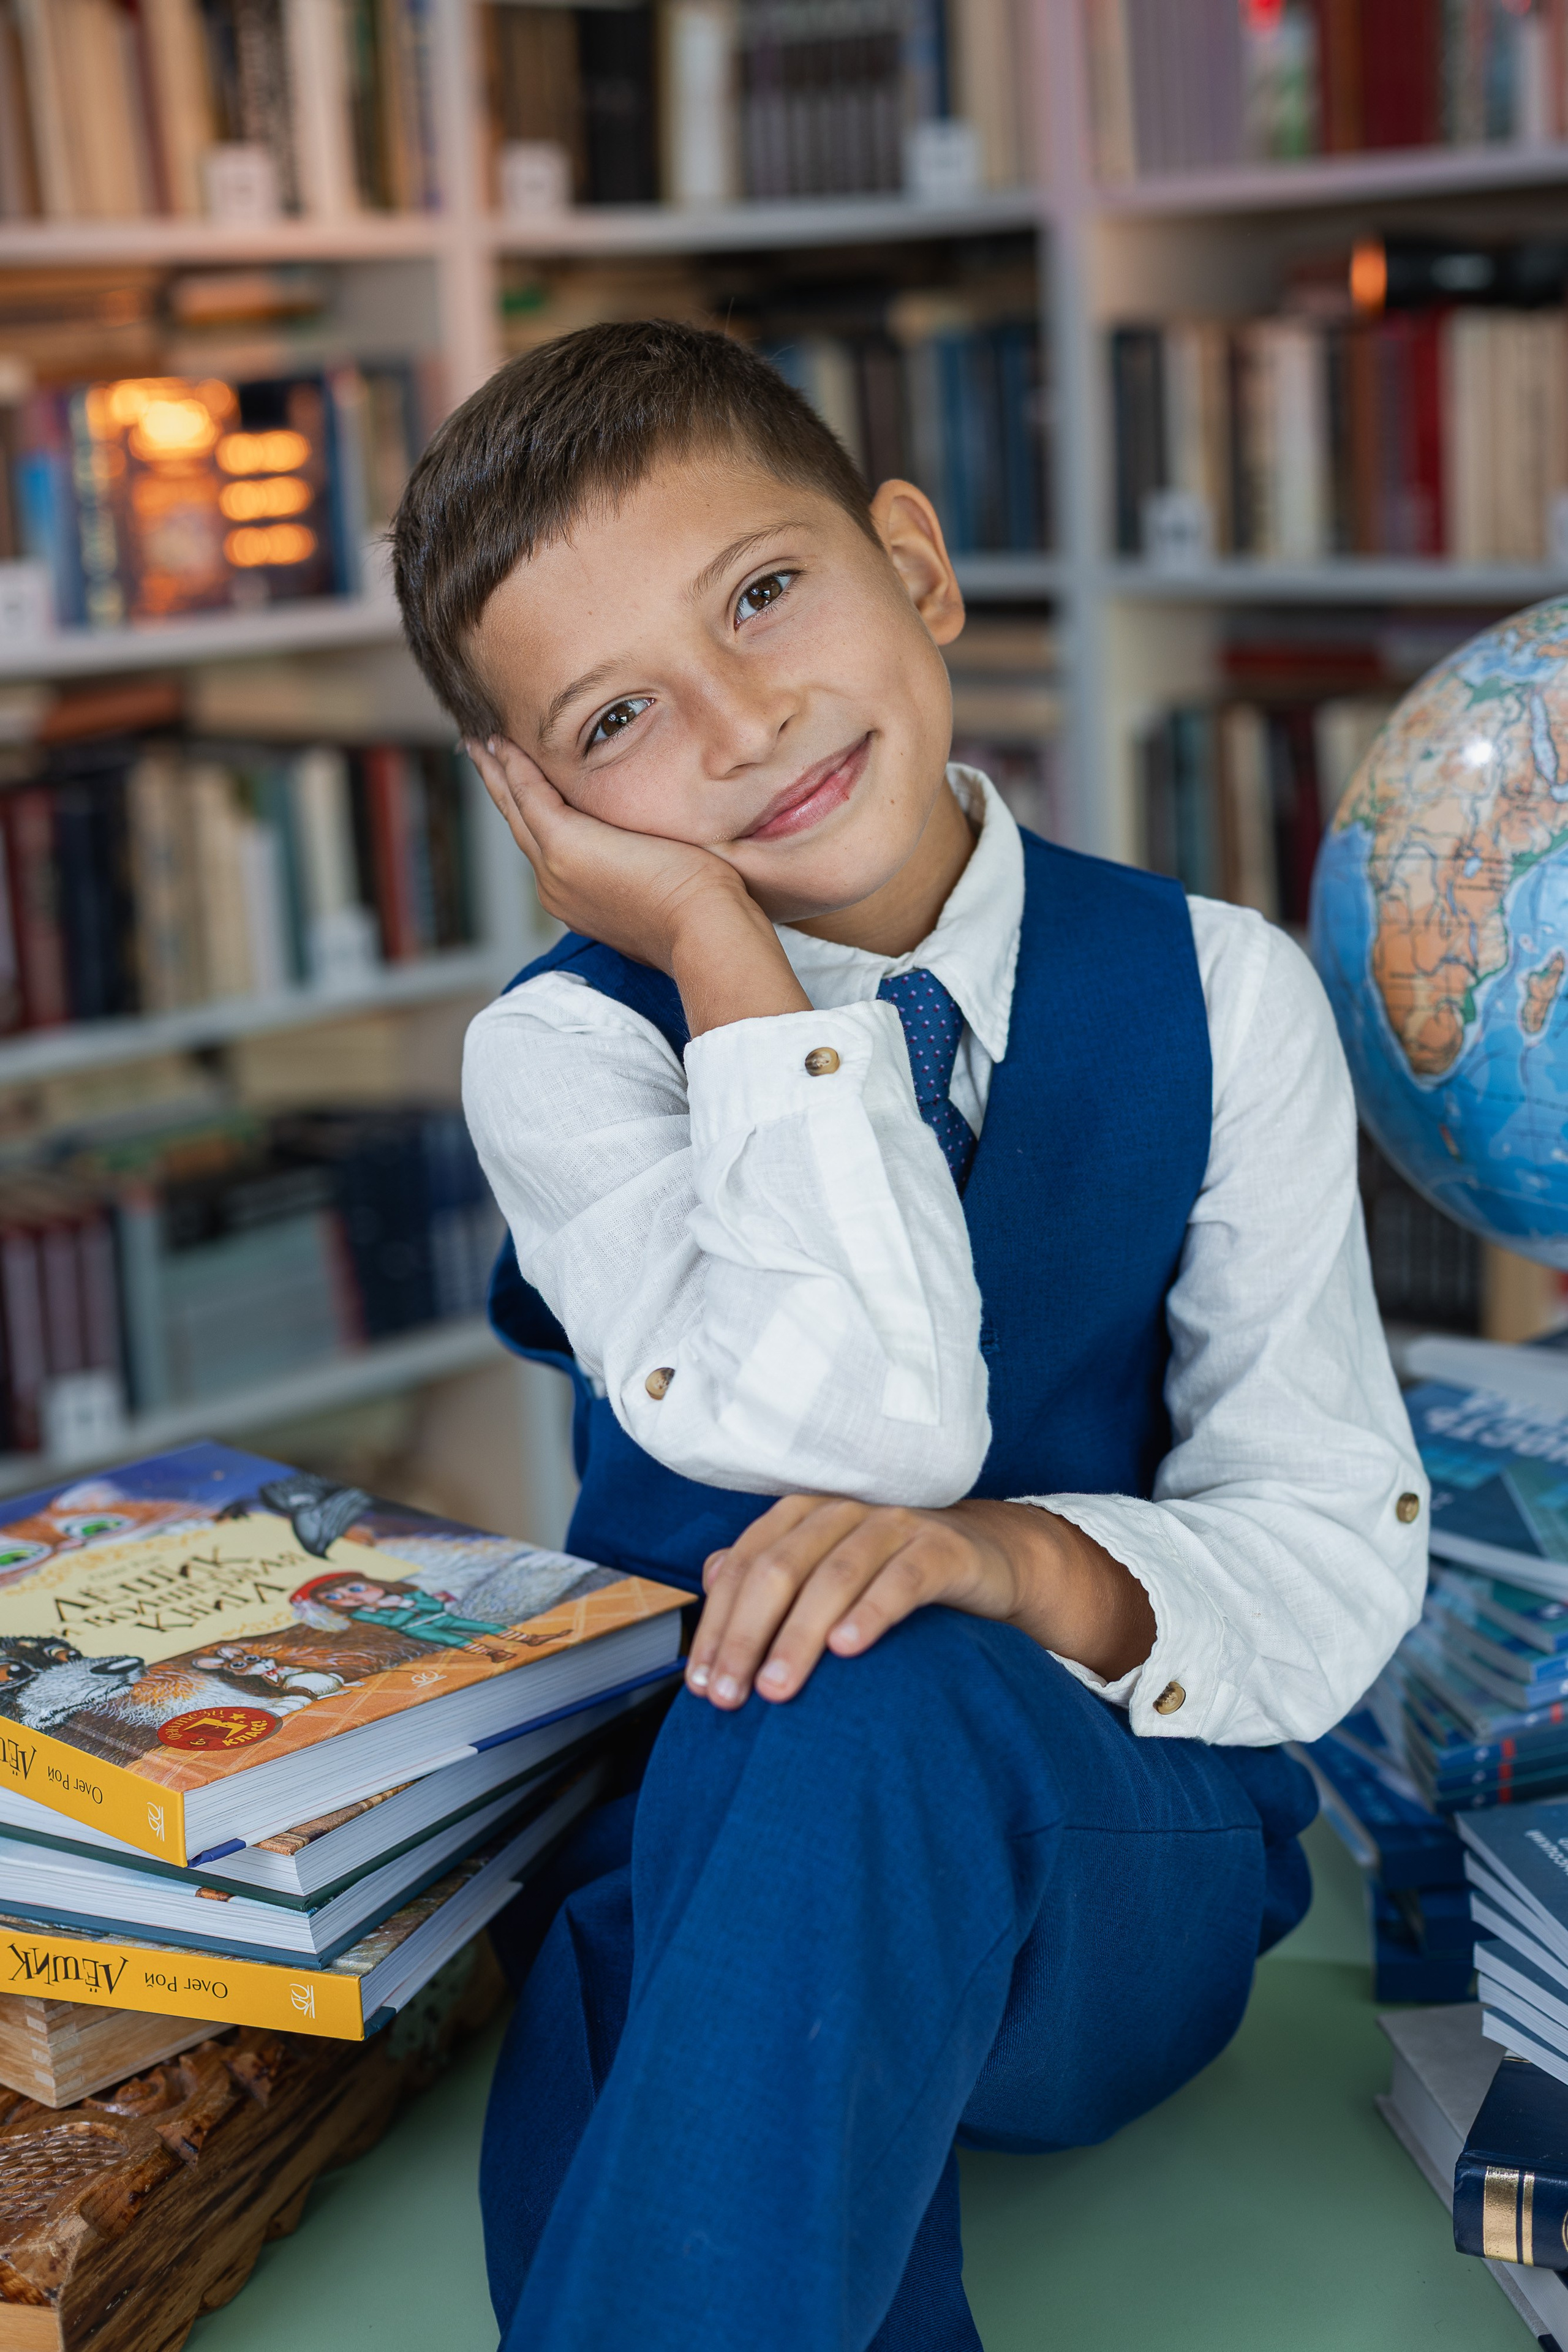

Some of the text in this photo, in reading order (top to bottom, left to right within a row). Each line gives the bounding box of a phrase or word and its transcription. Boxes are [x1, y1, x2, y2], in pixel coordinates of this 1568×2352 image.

[135, 1581, 287, 1632] КНИГА
[222, 1720, 268, 1746] КЛАСС!
[48, 1765, 103, 1804] Олег Рой
[145, 1972, 228, 1999] Олег Рой
